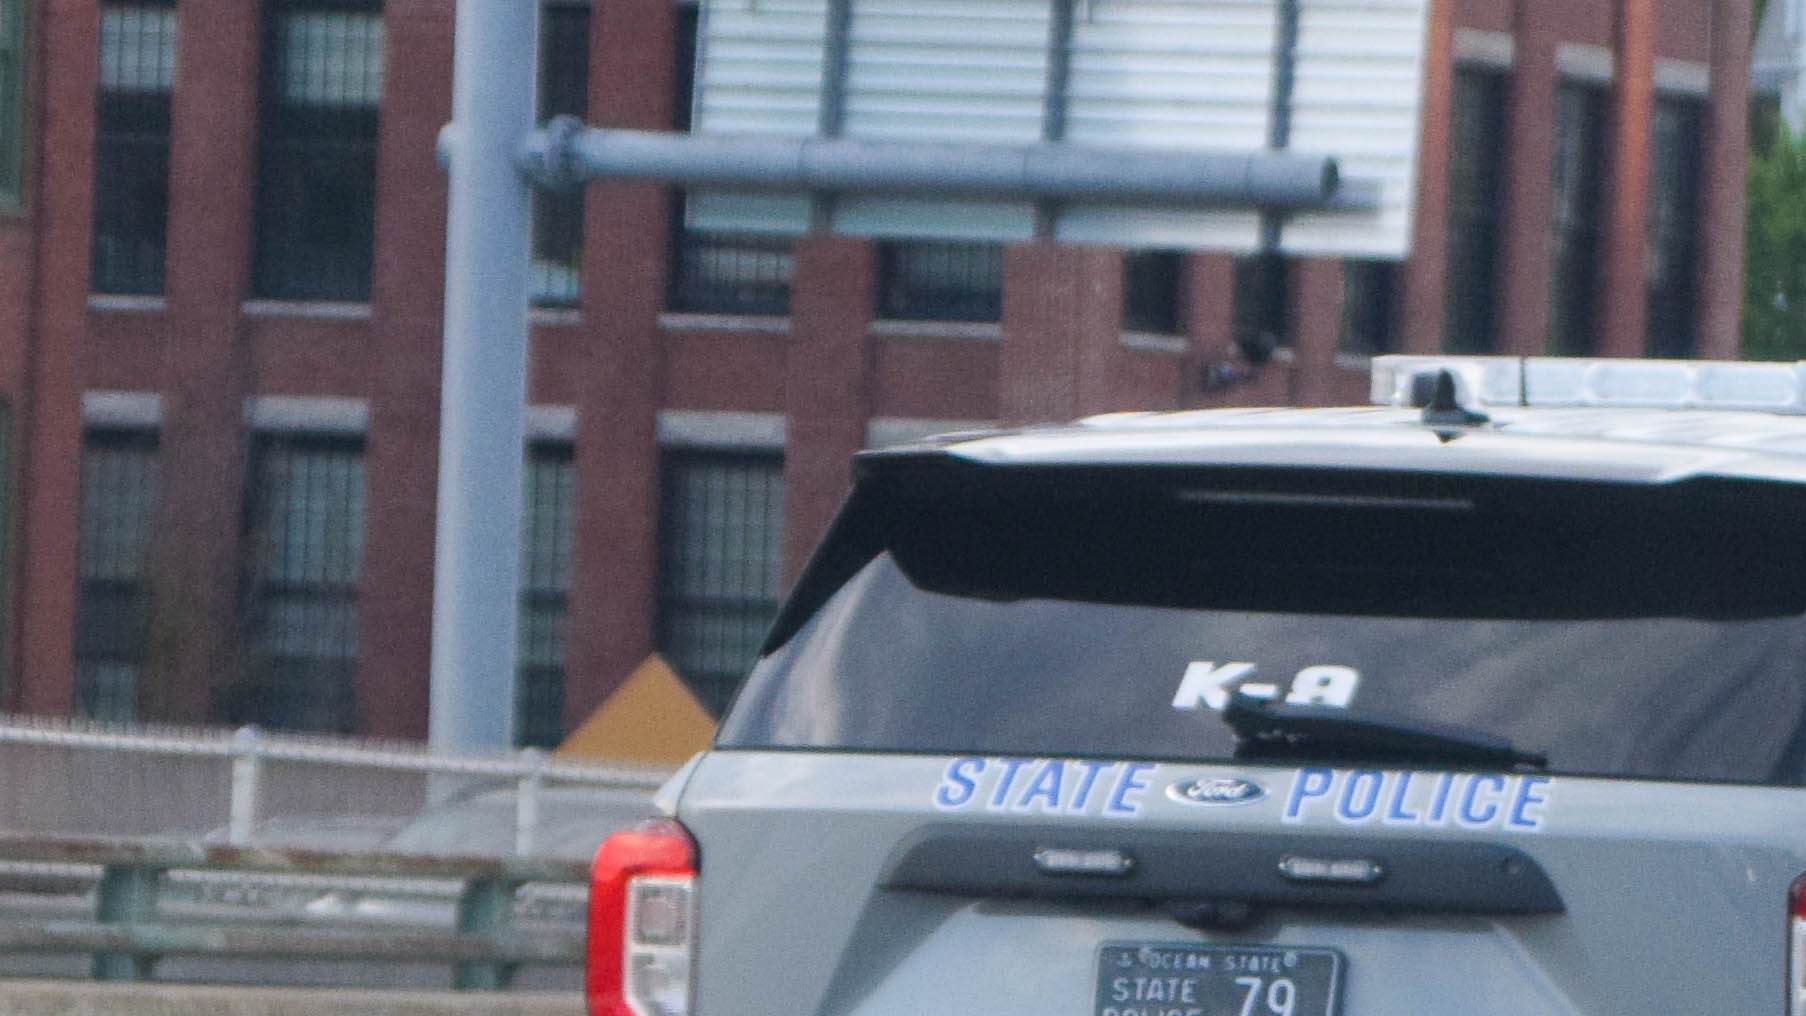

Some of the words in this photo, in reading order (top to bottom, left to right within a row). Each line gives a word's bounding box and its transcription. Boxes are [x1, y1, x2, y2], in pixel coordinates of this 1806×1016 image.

[934, 757, 1156, 818] STATE
[1283, 767, 1554, 831] POLICE
[1187, 776, 1250, 800] Ford
[1150, 952, 1211, 969] OCEAN
[1225, 955, 1281, 973] STATE
[1113, 976, 1197, 1004] STATE
